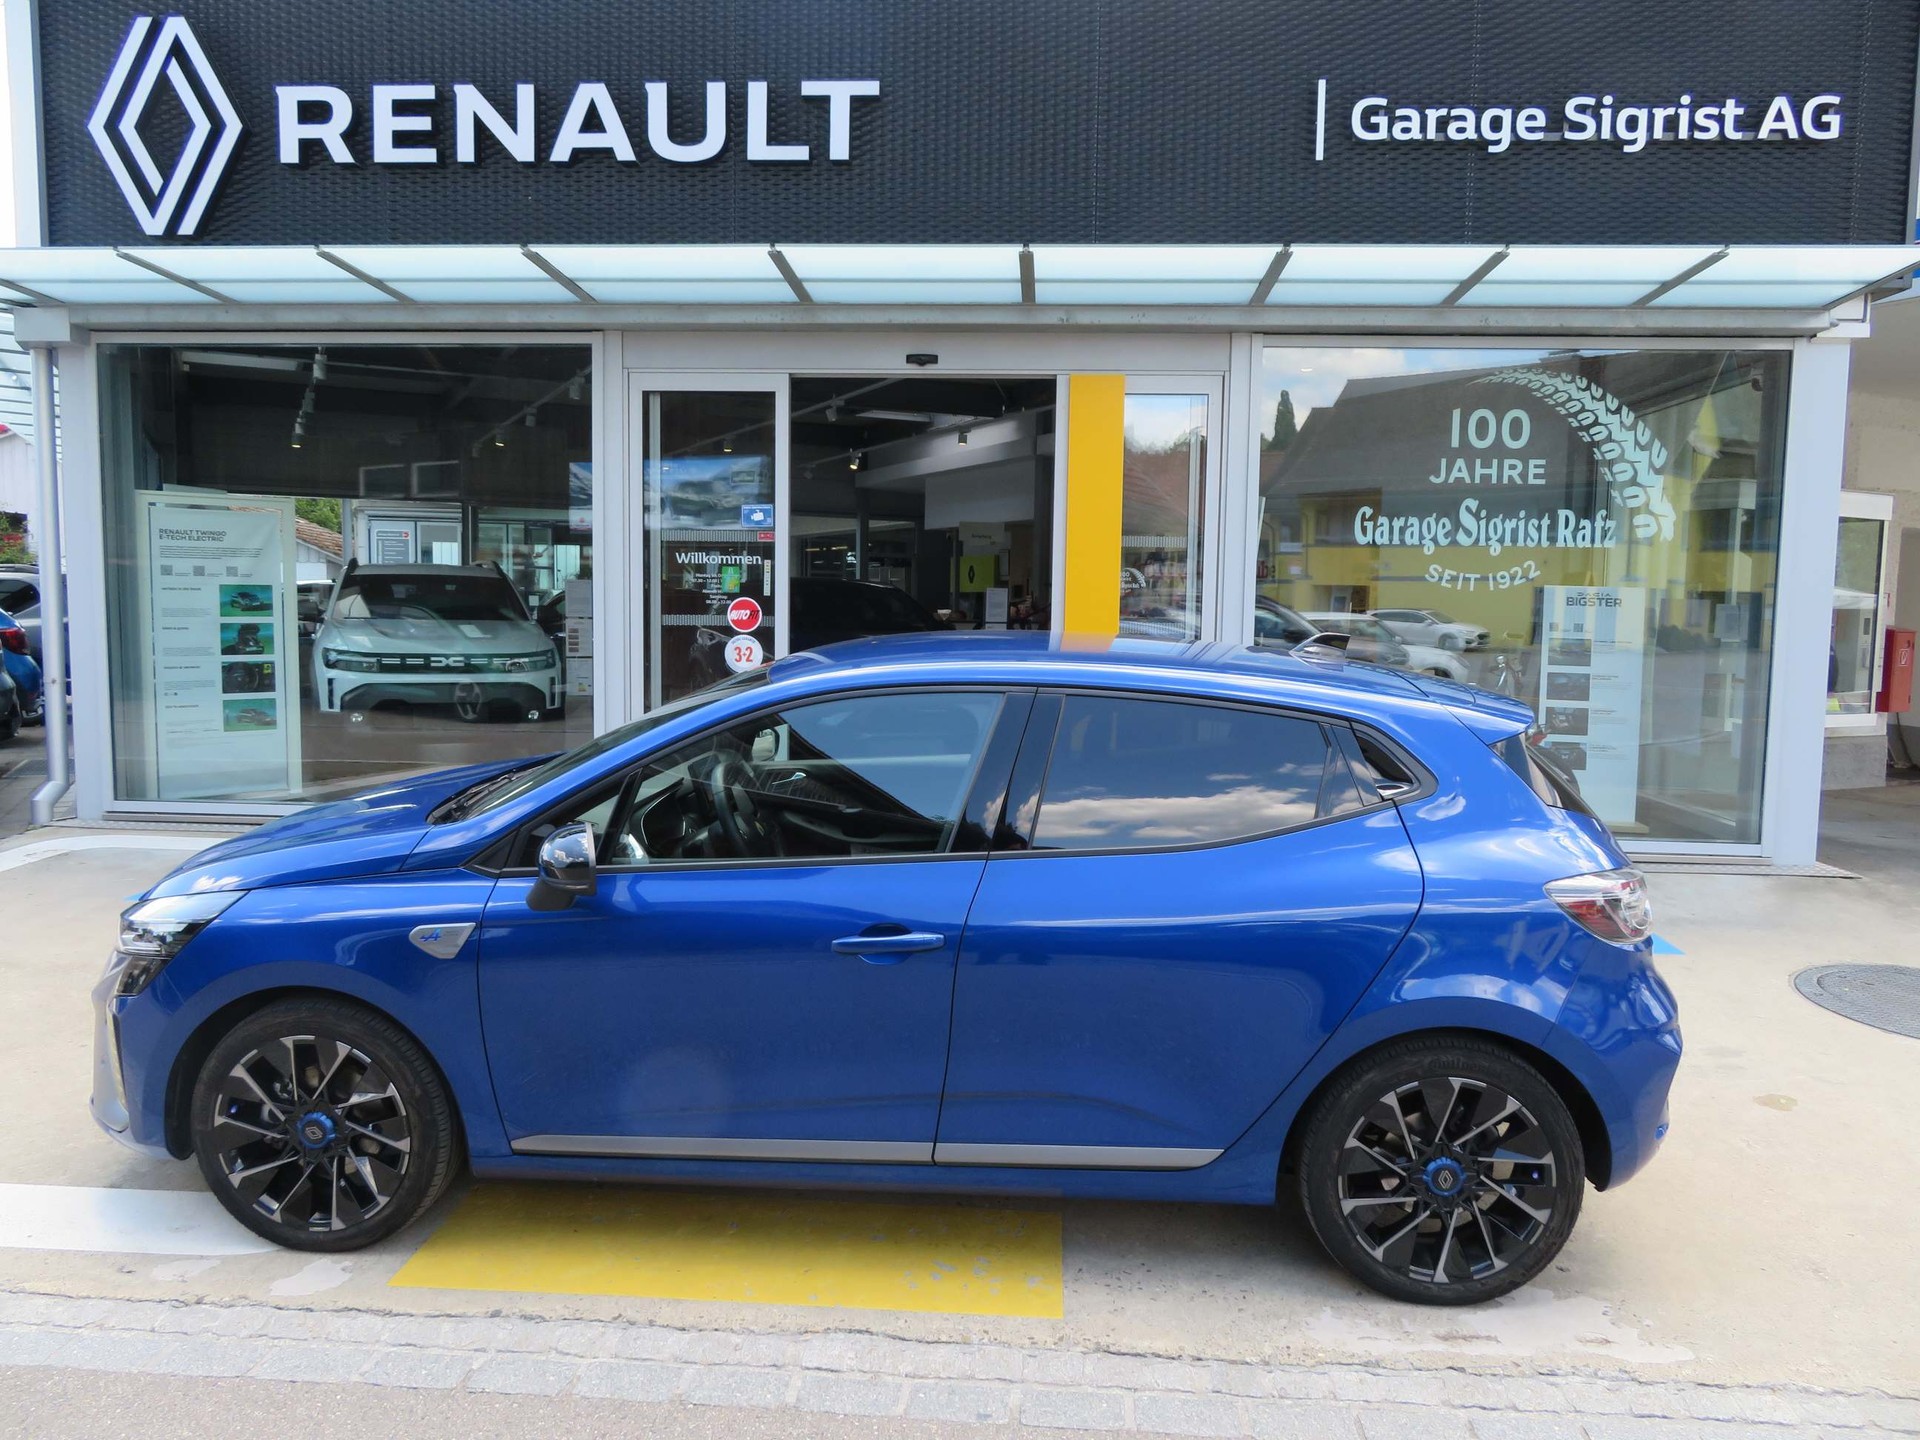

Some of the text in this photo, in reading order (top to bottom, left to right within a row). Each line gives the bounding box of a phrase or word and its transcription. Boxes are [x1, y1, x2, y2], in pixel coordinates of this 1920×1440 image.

[275, 80, 881, 164] RENAULT
[1350, 94, 1842, 153] Garage Sigrist AG
[1450, 407, 1531, 450] 100
[1429, 457, 1547, 485] JAHRE
[159, 528, 227, 537] RENAULT TWINGO
[1354, 497, 1617, 556] Garage Sigrist Rafz
[675, 552, 762, 565] Willkommen
[1424, 559, 1542, 592] SEIT 1922
[730, 609, 761, 620] AUTOFIT
[1566, 596, 1622, 608] BIGSTER
[734, 646, 753, 663] 3+2
